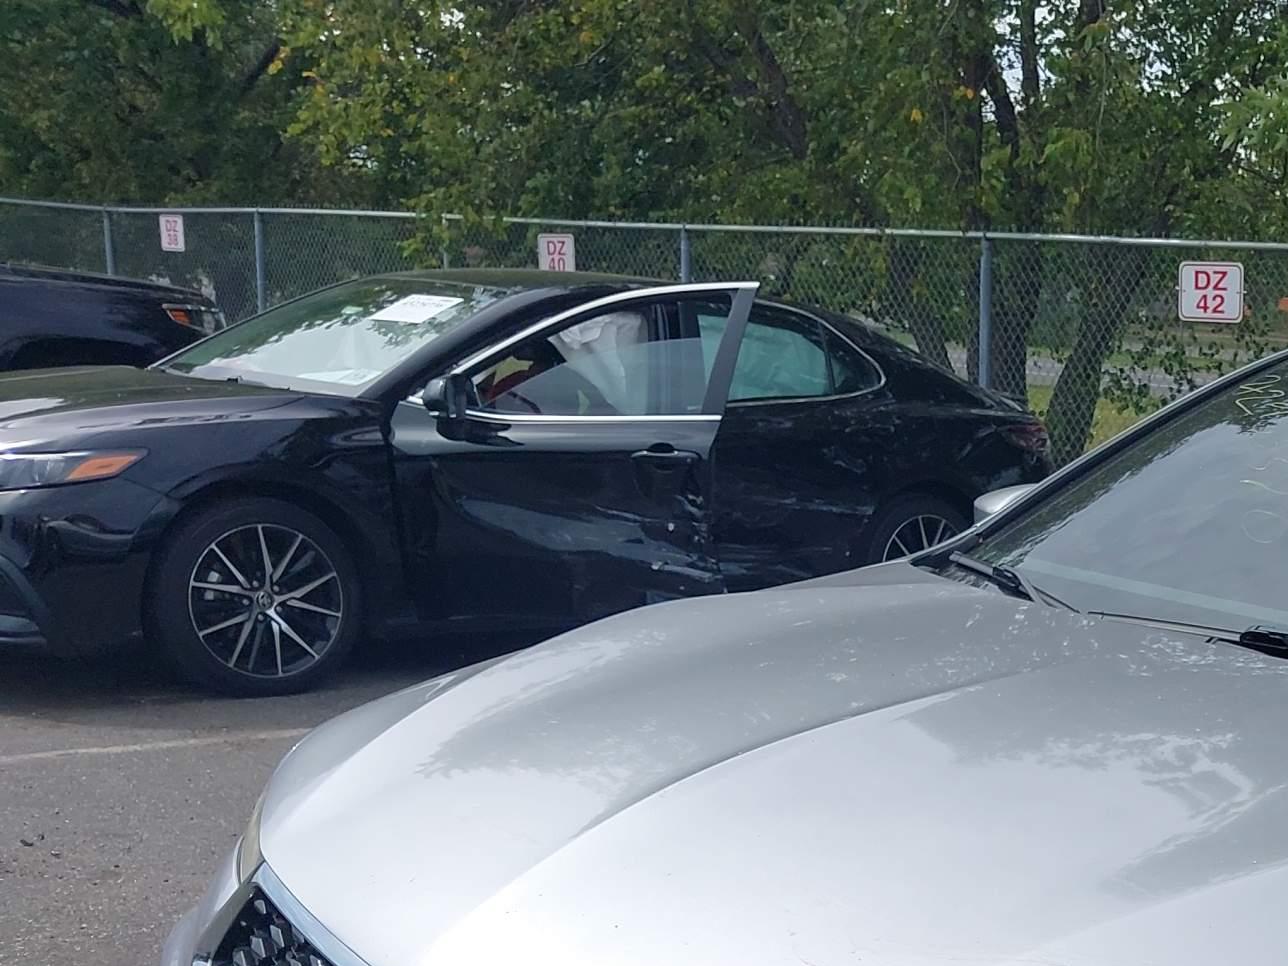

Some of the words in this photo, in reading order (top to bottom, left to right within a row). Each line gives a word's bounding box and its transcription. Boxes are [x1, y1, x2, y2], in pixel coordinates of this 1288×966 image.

[547, 240, 566, 256] DZ
[549, 257, 566, 272] 40
[1194, 270, 1228, 291] DZ
[1196, 294, 1225, 314] 42
